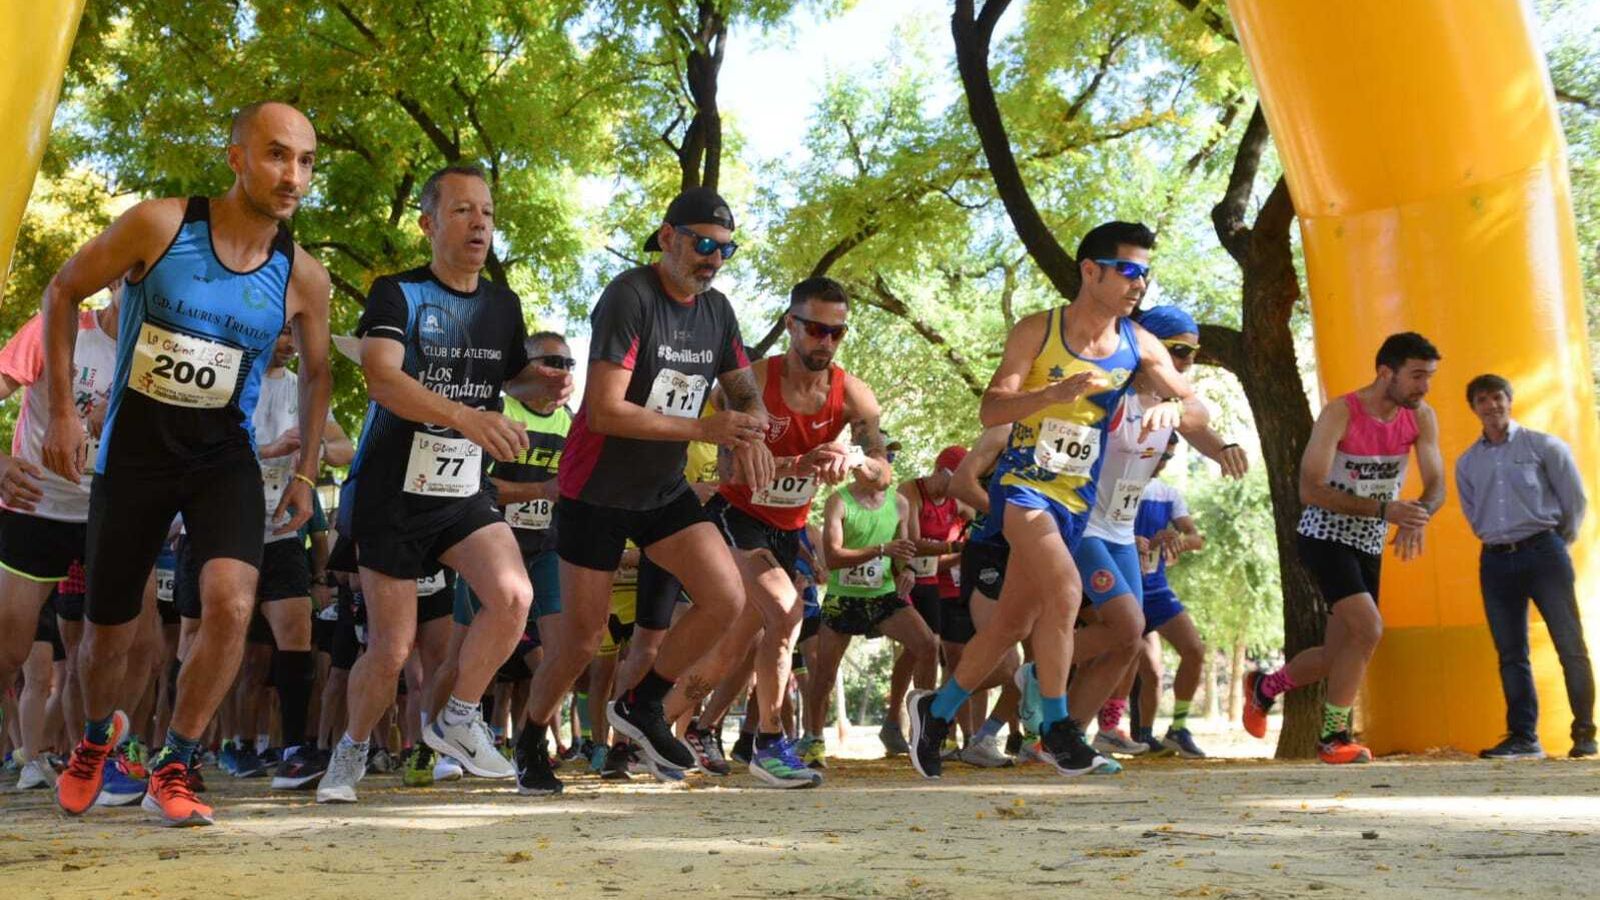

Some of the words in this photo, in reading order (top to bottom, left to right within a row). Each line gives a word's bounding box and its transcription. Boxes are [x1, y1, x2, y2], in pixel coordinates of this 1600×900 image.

[423, 346, 447, 358] CLUB
[450, 348, 461, 359] DE
[657, 343, 713, 364] #Sevilla10
[152, 354, 216, 390] 200
[1053, 437, 1092, 461] 109
[436, 456, 465, 477] 77
[772, 477, 808, 492] 107
[518, 500, 549, 516] 218
[848, 566, 876, 578] 216
